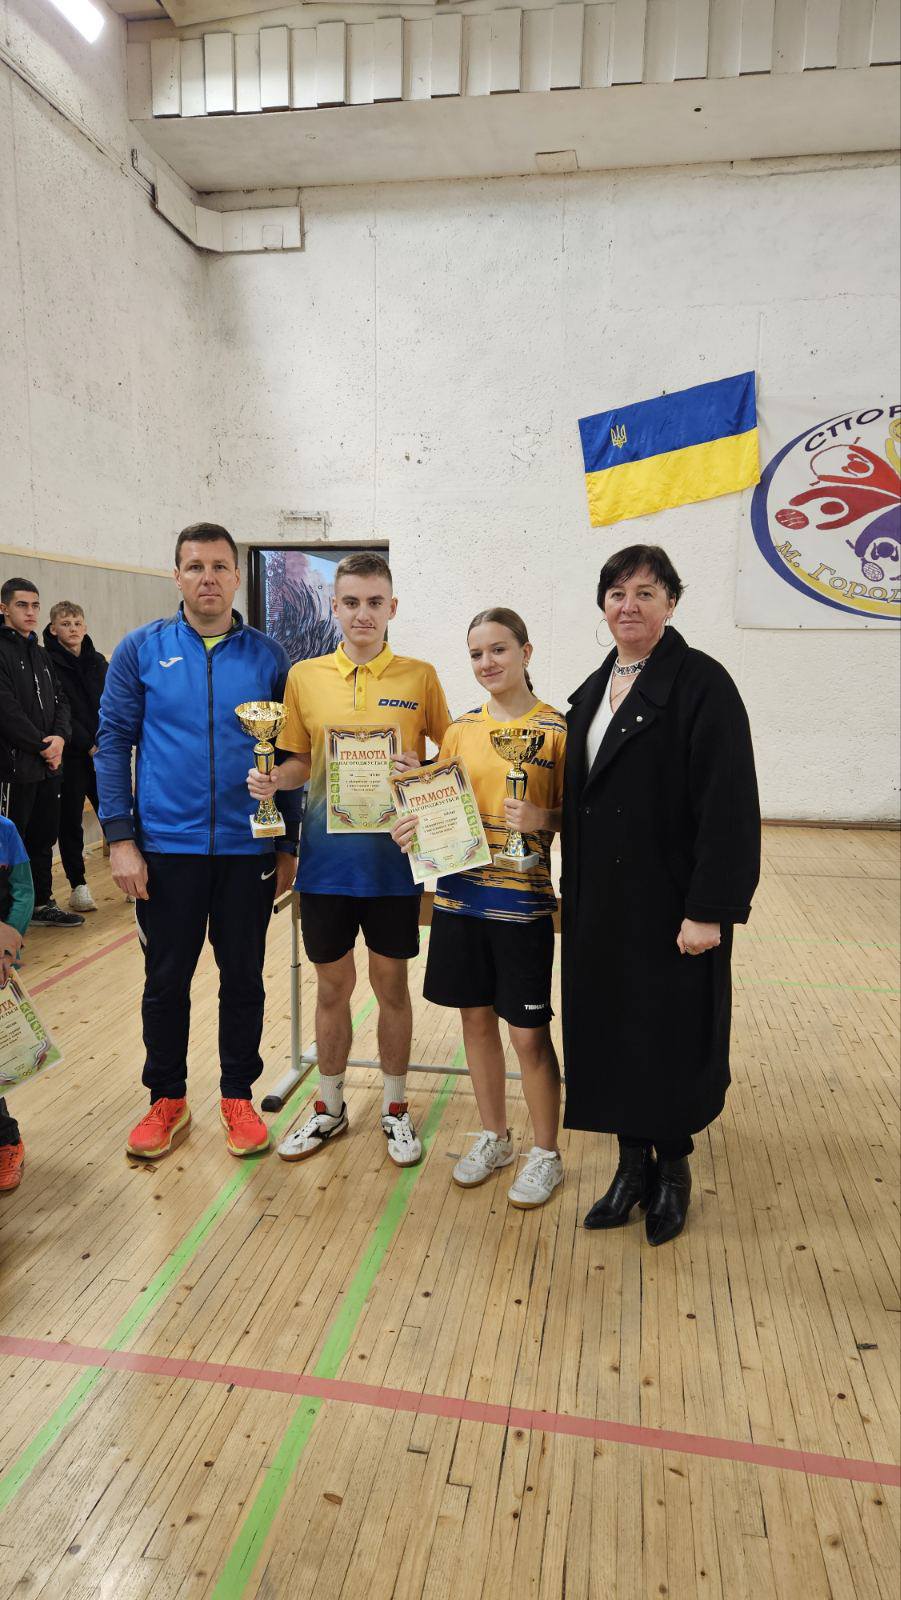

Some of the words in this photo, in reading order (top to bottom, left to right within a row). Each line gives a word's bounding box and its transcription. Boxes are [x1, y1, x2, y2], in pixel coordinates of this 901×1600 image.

[378, 698, 419, 711] DONIC
[339, 749, 387, 760] ГРАМОТА
[408, 785, 458, 808] ГРАМОТА
